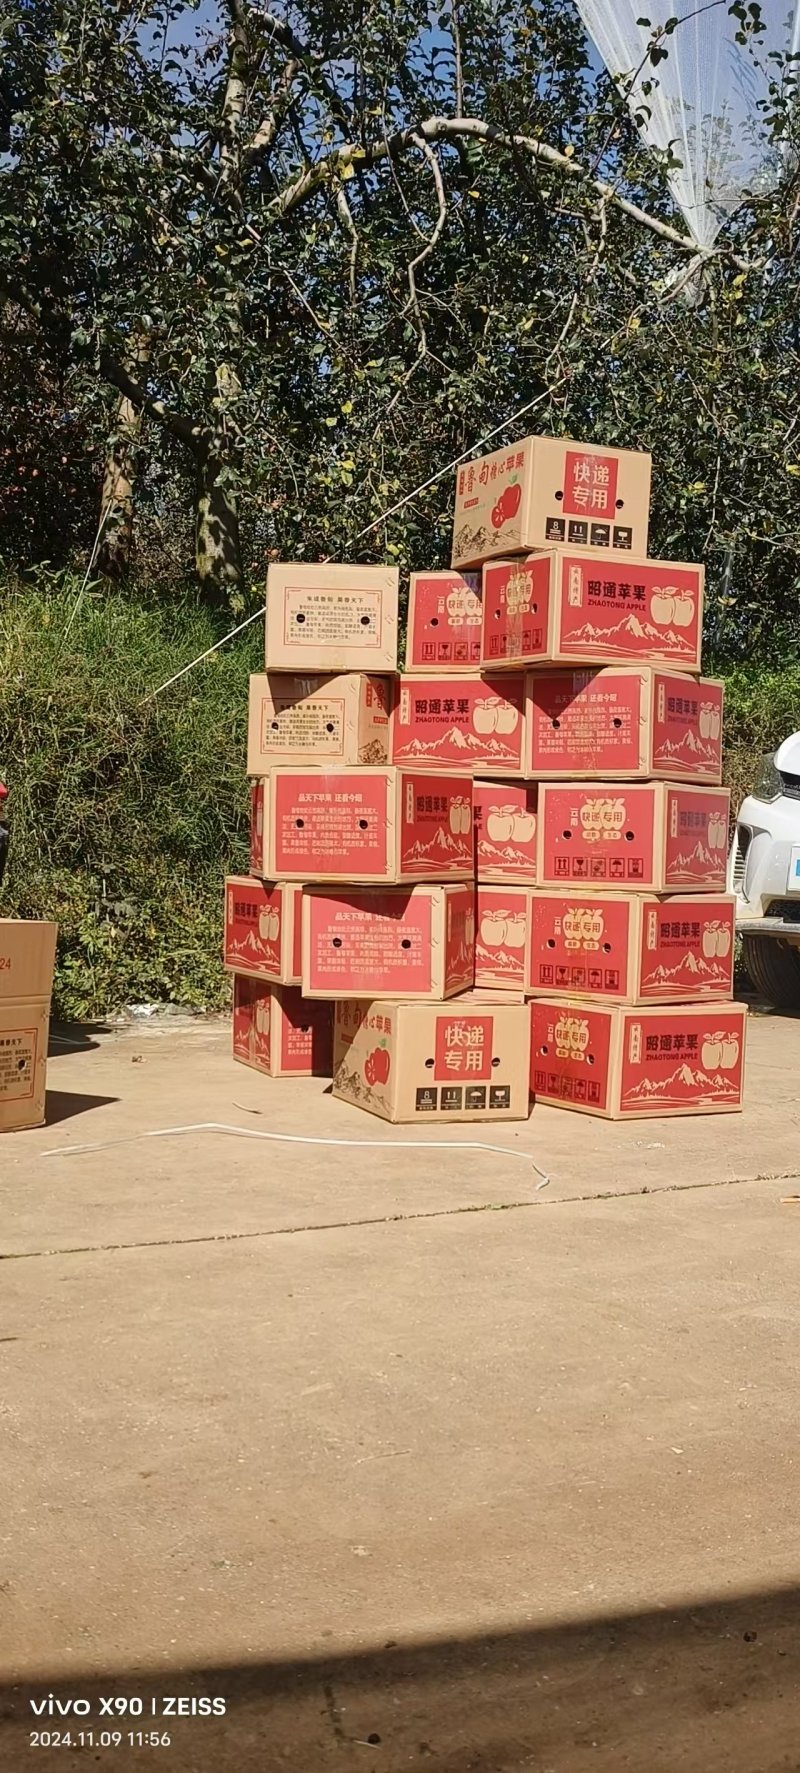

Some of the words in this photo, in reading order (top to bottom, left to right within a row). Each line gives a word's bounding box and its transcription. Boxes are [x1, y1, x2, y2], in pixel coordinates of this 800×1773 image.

[573, 461, 609, 486] 快递
[572, 485, 608, 509] 专用
[587, 580, 646, 601] 昭通苹果
[588, 599, 626, 610] ZHAOTONG
[626, 603, 646, 611] APPLE
[415, 699, 469, 714] 昭通苹果
[661, 922, 700, 938] 昭通苹果
[445, 1025, 484, 1047] 快递
[646, 1034, 698, 1051] 昭通苹果
[444, 1050, 483, 1071] 专用
[680, 1052, 698, 1060] APPLE
